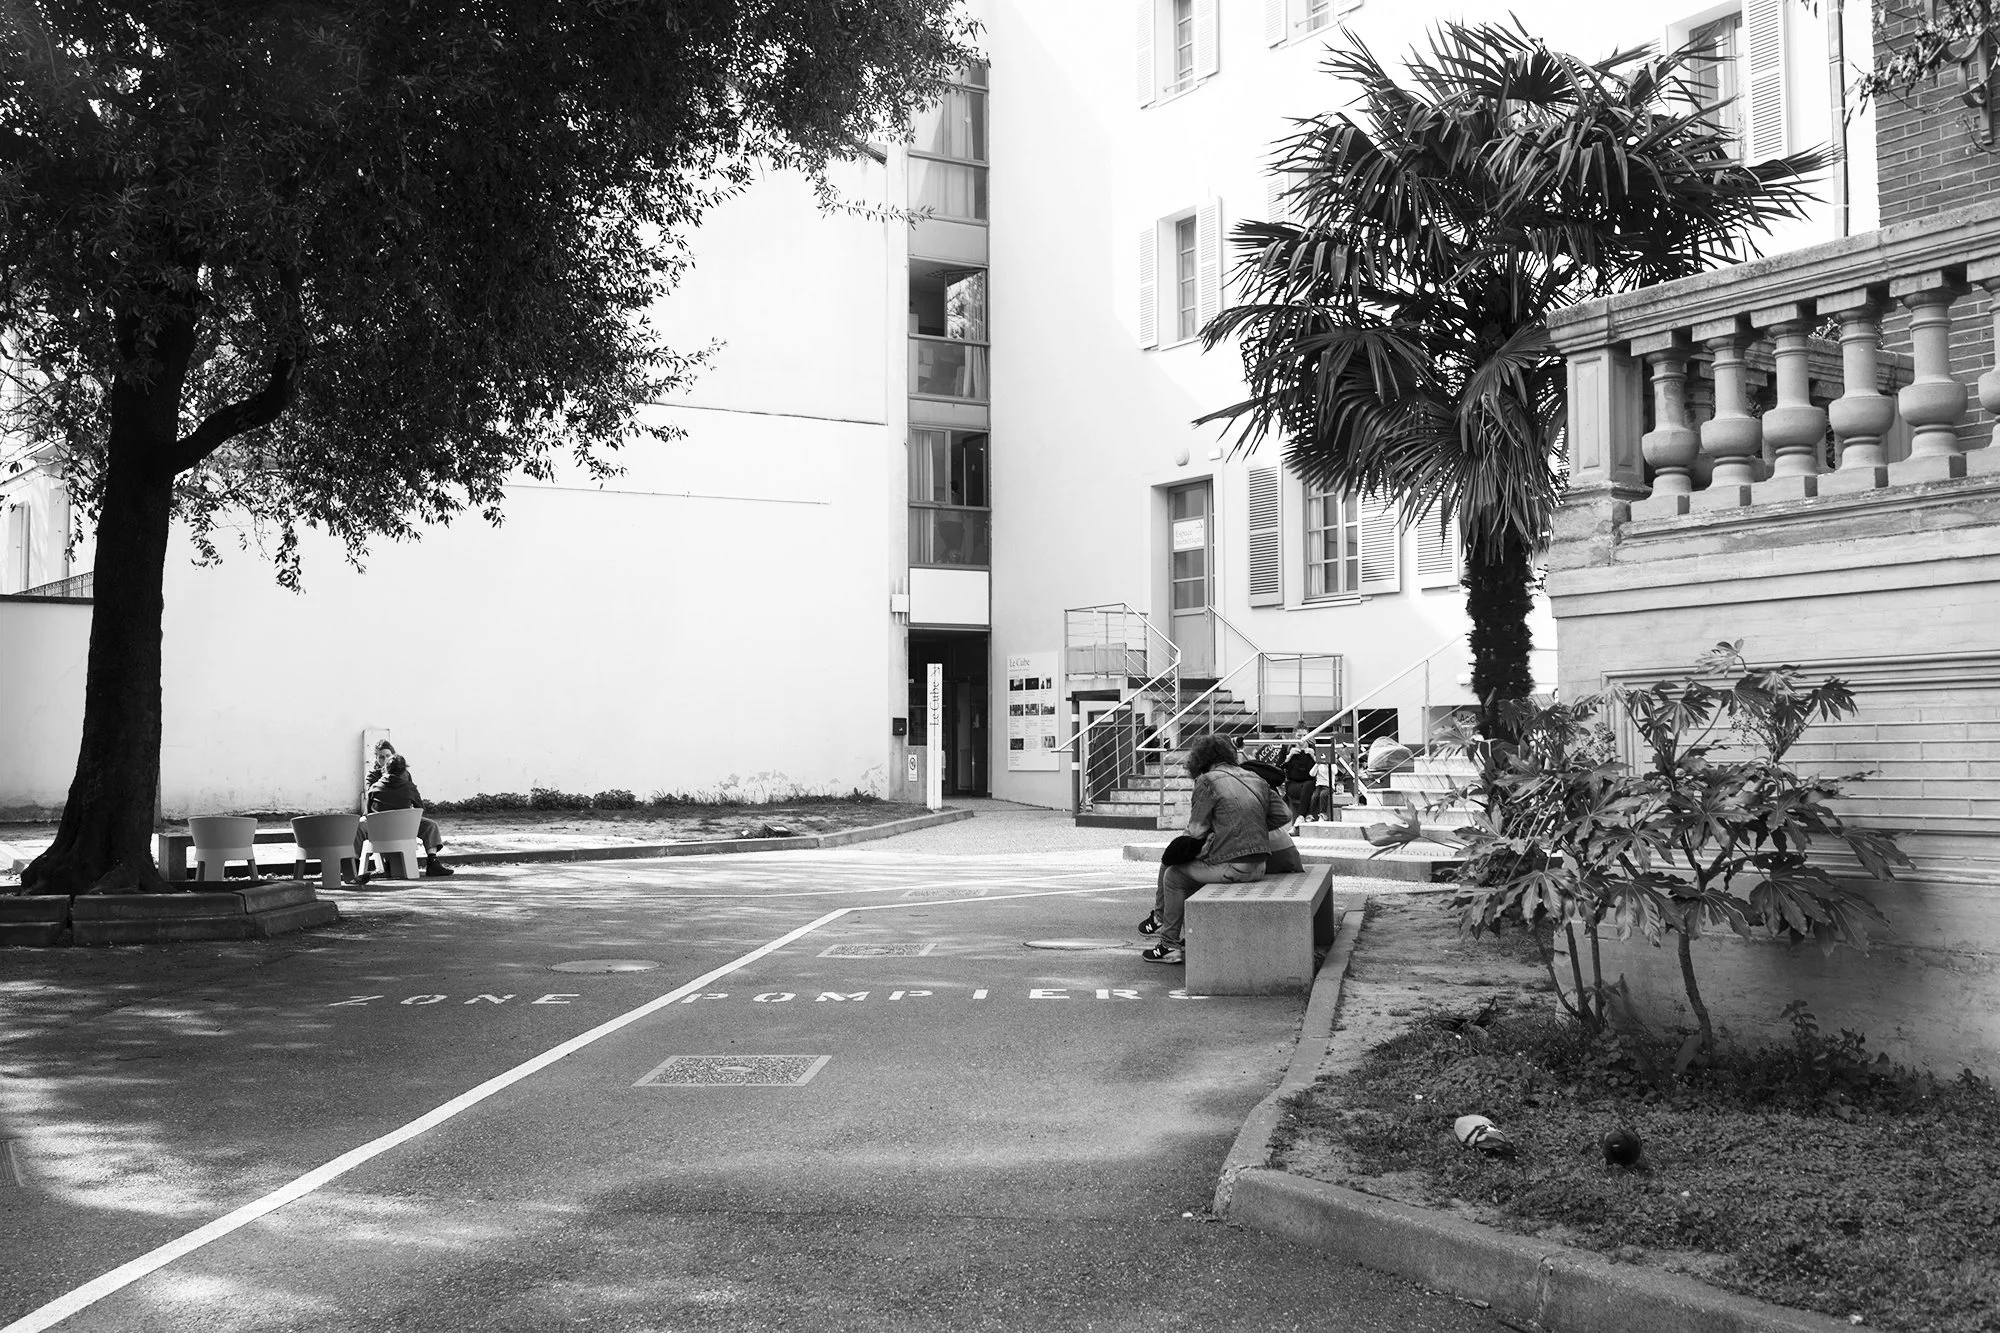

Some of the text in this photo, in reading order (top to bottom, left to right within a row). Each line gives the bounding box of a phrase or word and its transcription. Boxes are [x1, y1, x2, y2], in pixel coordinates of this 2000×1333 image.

[929, 681, 940, 726] Le Cube
[1145, 923, 1153, 933] N
[1153, 948, 1161, 957] N
[328, 994, 580, 1007] ZONE
